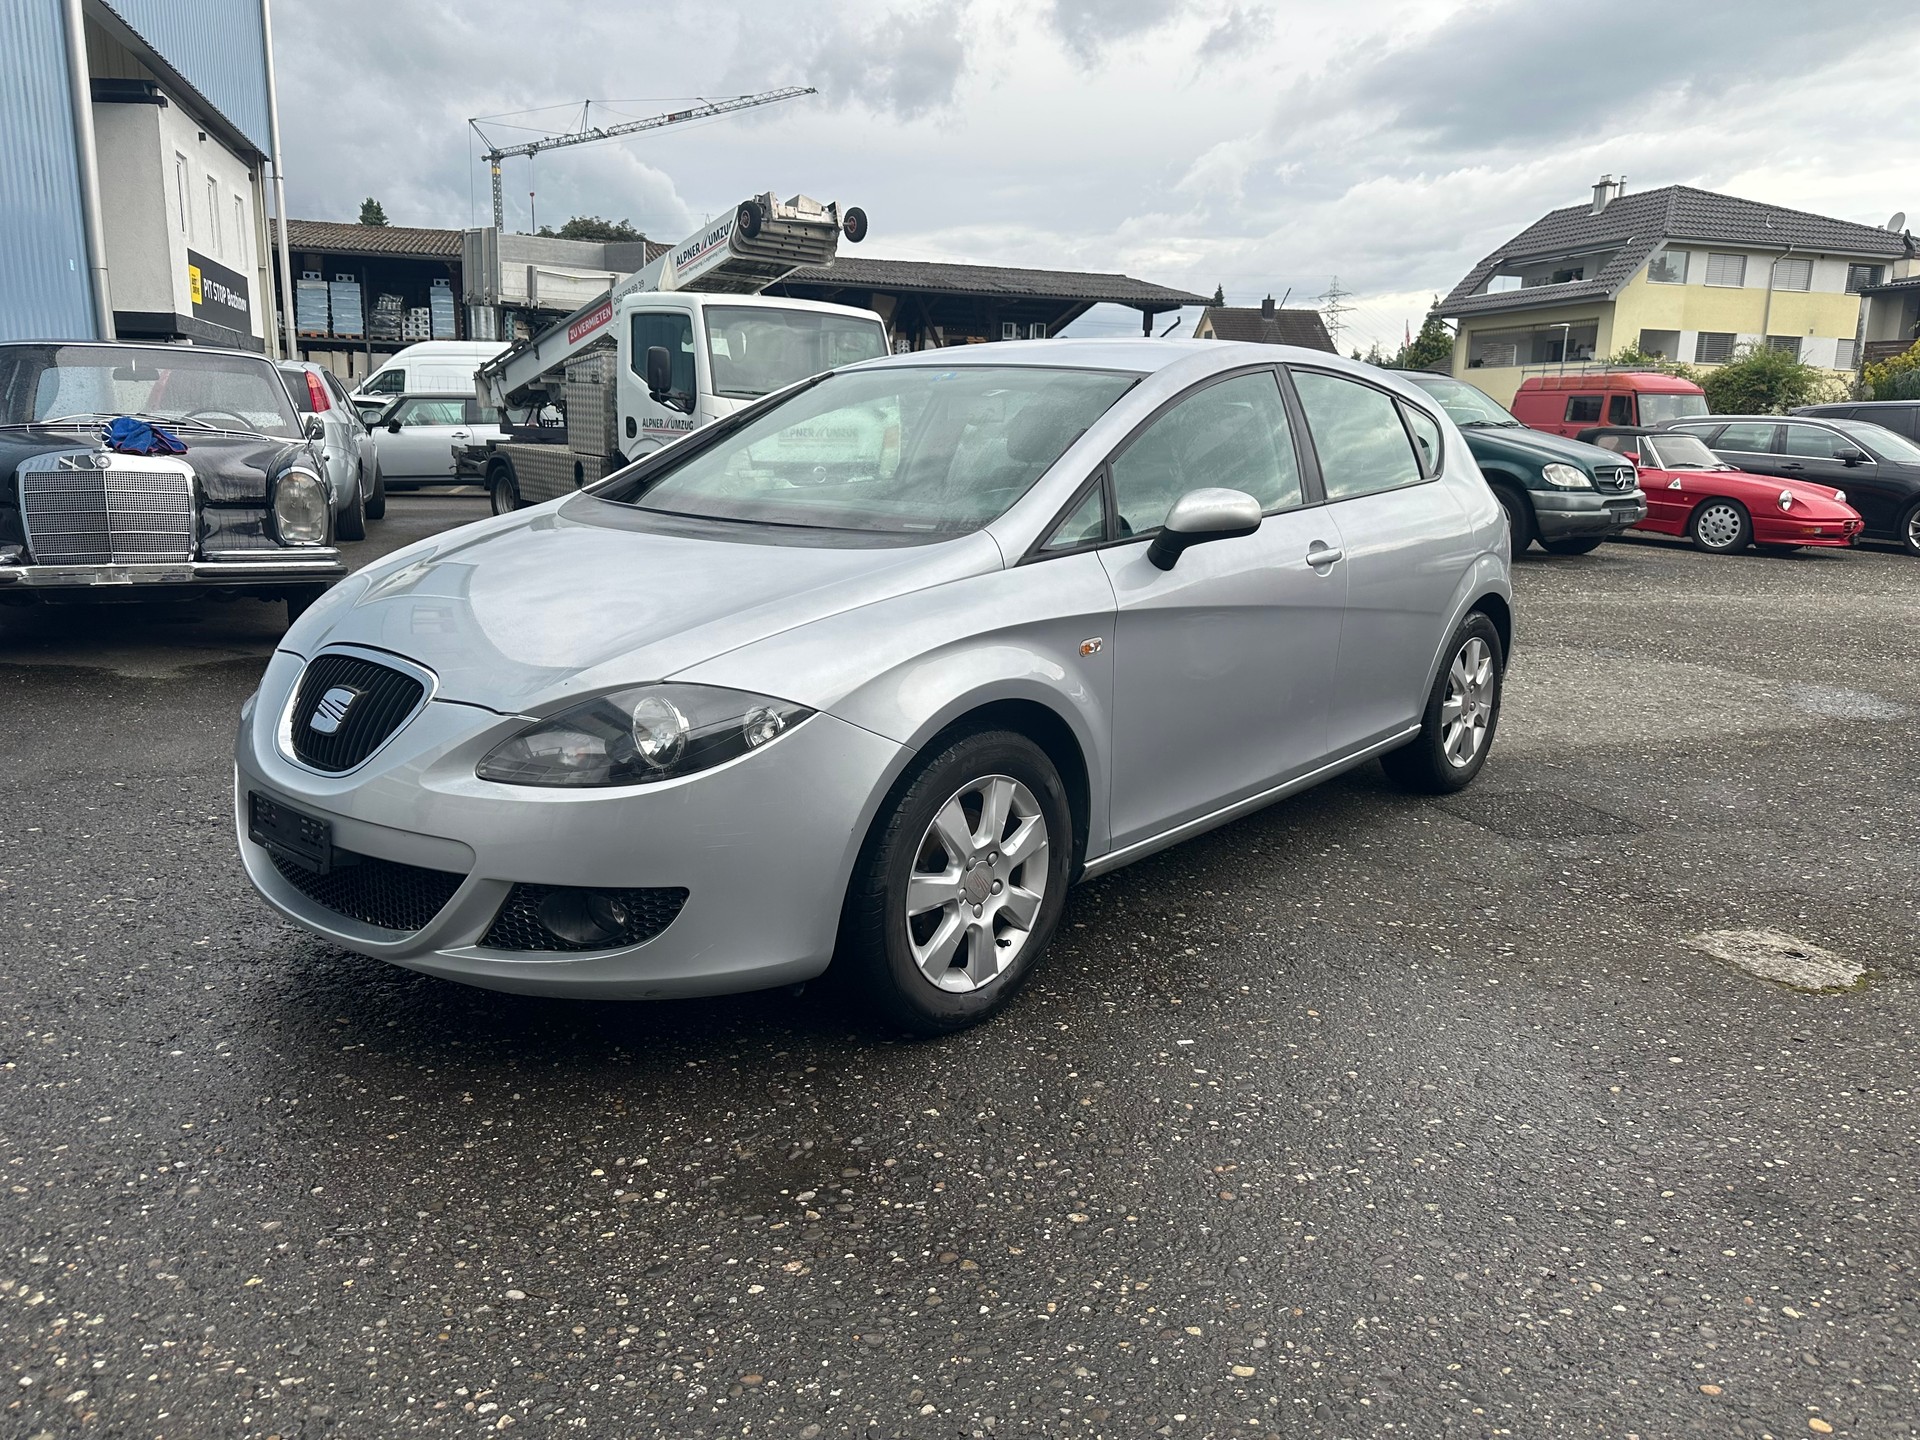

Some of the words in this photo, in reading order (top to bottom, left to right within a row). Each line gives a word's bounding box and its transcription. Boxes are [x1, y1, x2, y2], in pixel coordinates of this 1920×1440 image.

[677, 242, 700, 267] ALPNER
[203, 277, 213, 299] PIT
[213, 281, 227, 304] STOP
[638, 279, 645, 290] 39
[569, 326, 579, 340] ZU
[577, 306, 612, 335] VERMIETEN
[642, 417, 664, 428] ALPNER
[670, 419, 694, 430] UMZUG
